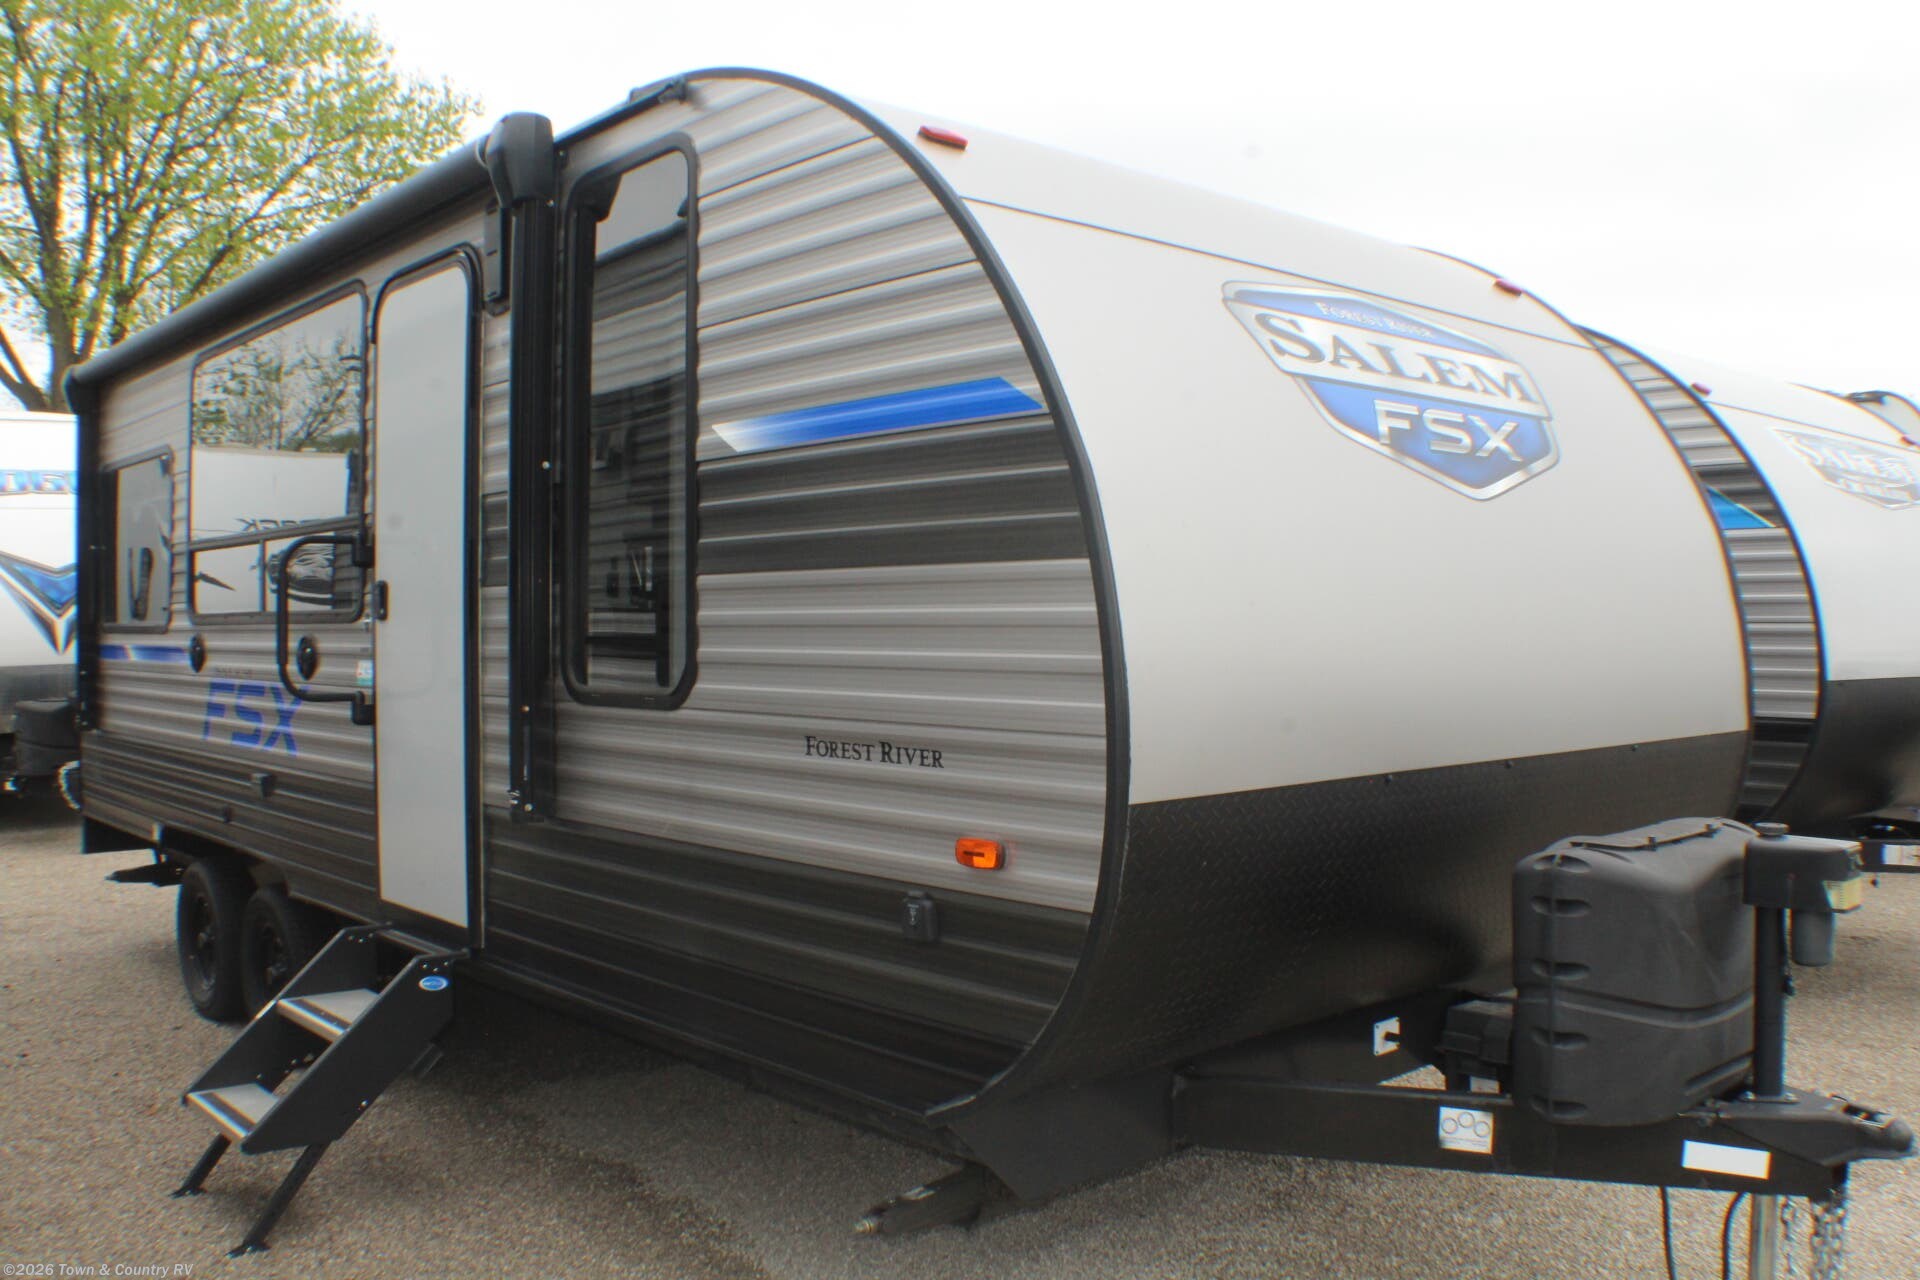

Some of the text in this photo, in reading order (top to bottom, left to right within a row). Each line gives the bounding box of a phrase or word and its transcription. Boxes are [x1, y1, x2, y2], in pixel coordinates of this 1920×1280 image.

[1254, 312, 1540, 403] SALEM
[1373, 399, 1523, 462] FSX
[203, 678, 313, 757] FSX
[804, 735, 945, 769] FOREST RIVER
